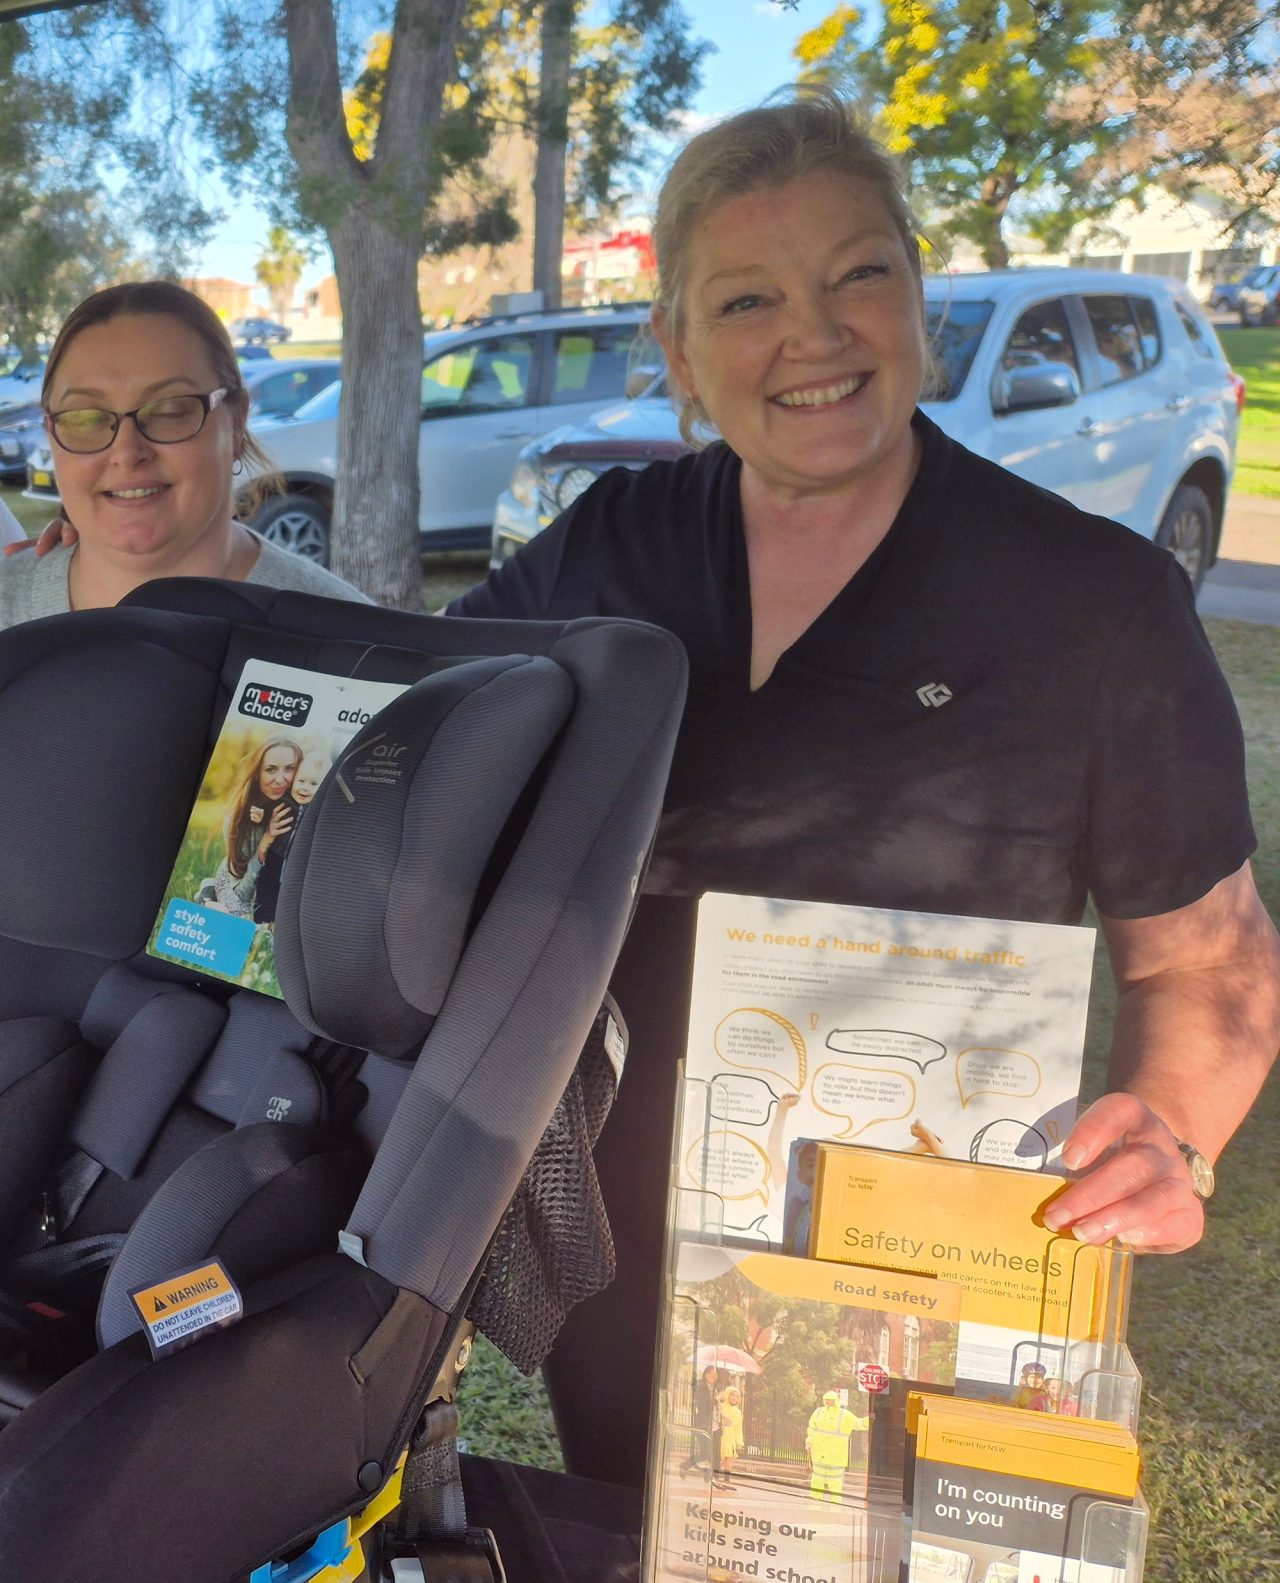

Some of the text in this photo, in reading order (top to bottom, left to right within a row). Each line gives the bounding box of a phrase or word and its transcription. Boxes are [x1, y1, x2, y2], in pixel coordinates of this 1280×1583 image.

[337, 708, 376, 726] ado
[372, 742, 408, 758] air
[174, 909, 207, 926] style
[169, 923, 211, 945] safety
[165, 937, 217, 960] comfort
[726, 927, 1026, 967] We need a hand around traffic
[742, 1026, 760, 1034] think
[737, 1041, 771, 1051] ourselves
[753, 1036, 776, 1044] things
[726, 1048, 745, 1056] often
[884, 1044, 922, 1054] distracted
[837, 1075, 858, 1084] might
[860, 1077, 879, 1085] learn
[880, 1081, 902, 1089] things
[973, 1077, 990, 1085] hard
[1011, 1073, 1027, 1081] find
[850, 1084, 862, 1092] but
[864, 1085, 877, 1093] this
[831, 1097, 841, 1105] do
[856, 1092, 876, 1101] know
[878, 1095, 895, 1103] what
[732, 1150, 755, 1158] always
[984, 1145, 999, 1153] and
[731, 1156, 753, 1165] where
[984, 1154, 1002, 1163] may
[848, 1175, 878, 1184] Transport
[858, 1183, 874, 1191] NSW
[844, 1227, 1062, 1277] Safety on wheels
[940, 1271, 958, 1279] and
[960, 1273, 988, 1284] carers
[1004, 1280, 1019, 1289] the
[1021, 1283, 1038, 1292] law
[167, 1277, 219, 1305] WARNING
[833, 1280, 938, 1310] Road safety
[973, 1286, 1014, 1299] scooters,
[152, 1293, 236, 1333] DO NOT LEAVE CHILDREN
[157, 1317, 203, 1343] UNATTENDED
[204, 1314, 212, 1323] IN
[224, 1303, 238, 1315] CAR
[941, 1436, 1006, 1453] Transport for NSW
[972, 1488, 1066, 1520] counting
[685, 1502, 817, 1541] Keeping our
[935, 1503, 1004, 1528] on you
[684, 1523, 778, 1557] kids safe
[682, 1550, 759, 1576] around
